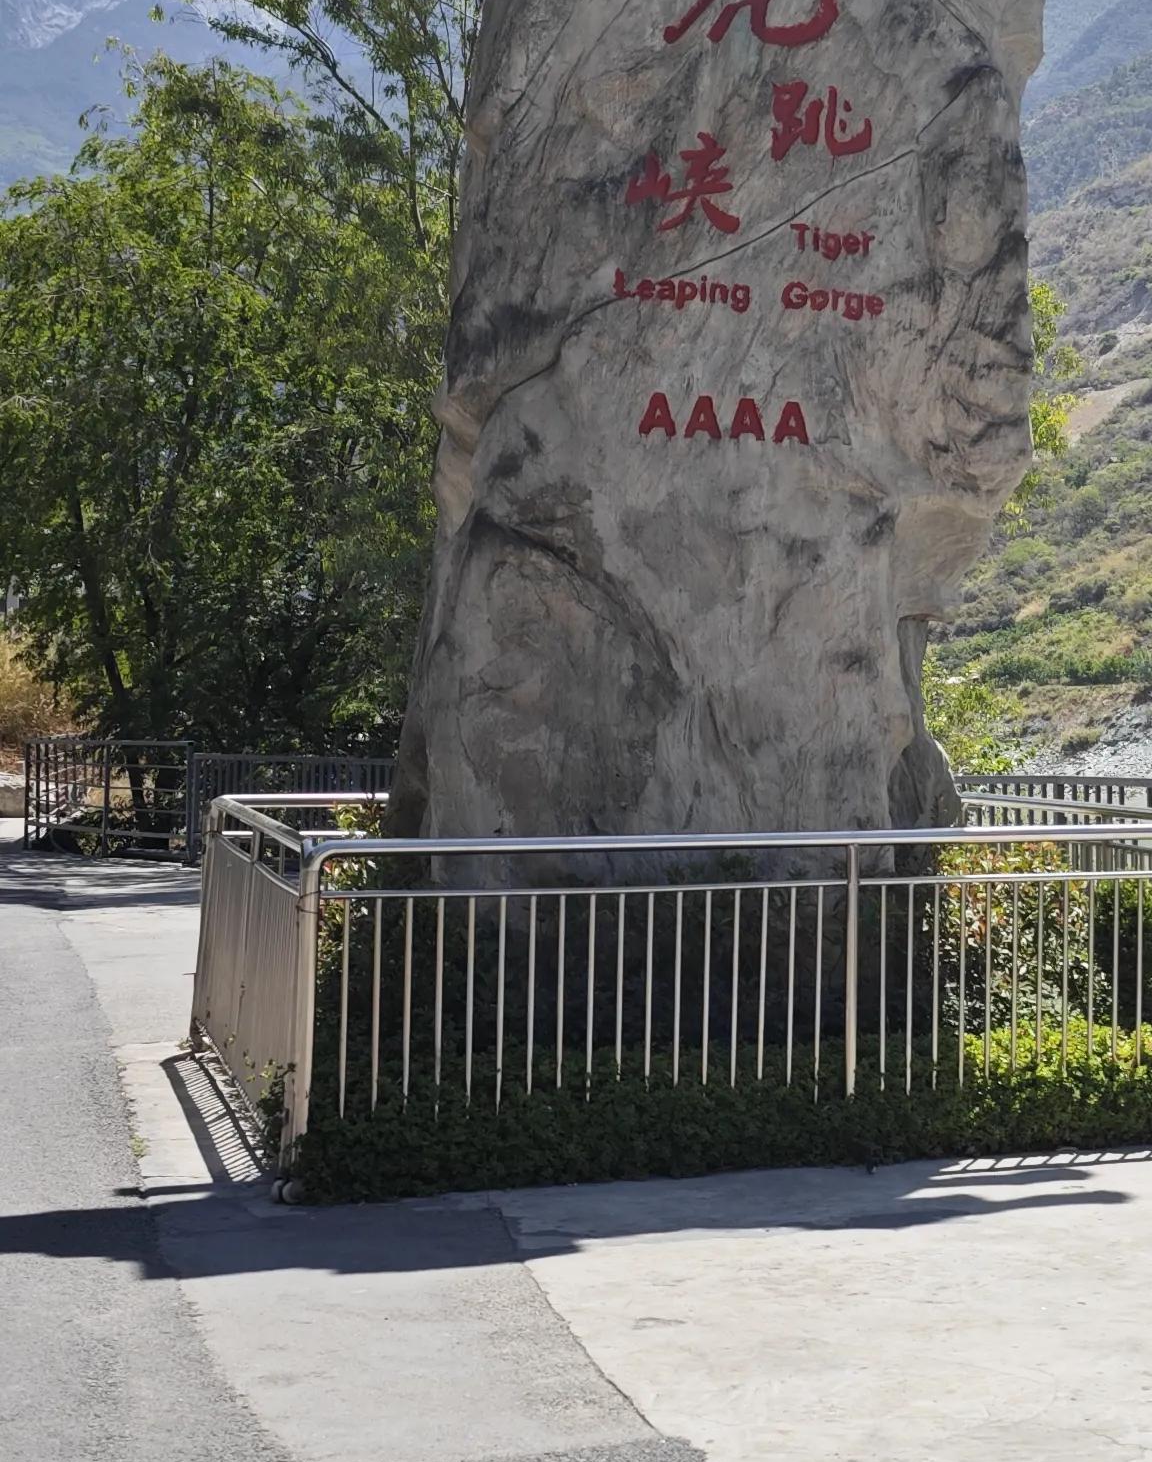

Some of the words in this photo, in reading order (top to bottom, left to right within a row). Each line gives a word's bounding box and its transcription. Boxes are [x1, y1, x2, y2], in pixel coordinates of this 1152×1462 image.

[789, 222, 876, 260] Tiger
[613, 268, 752, 314] Leaping
[780, 280, 885, 321] Gorge
